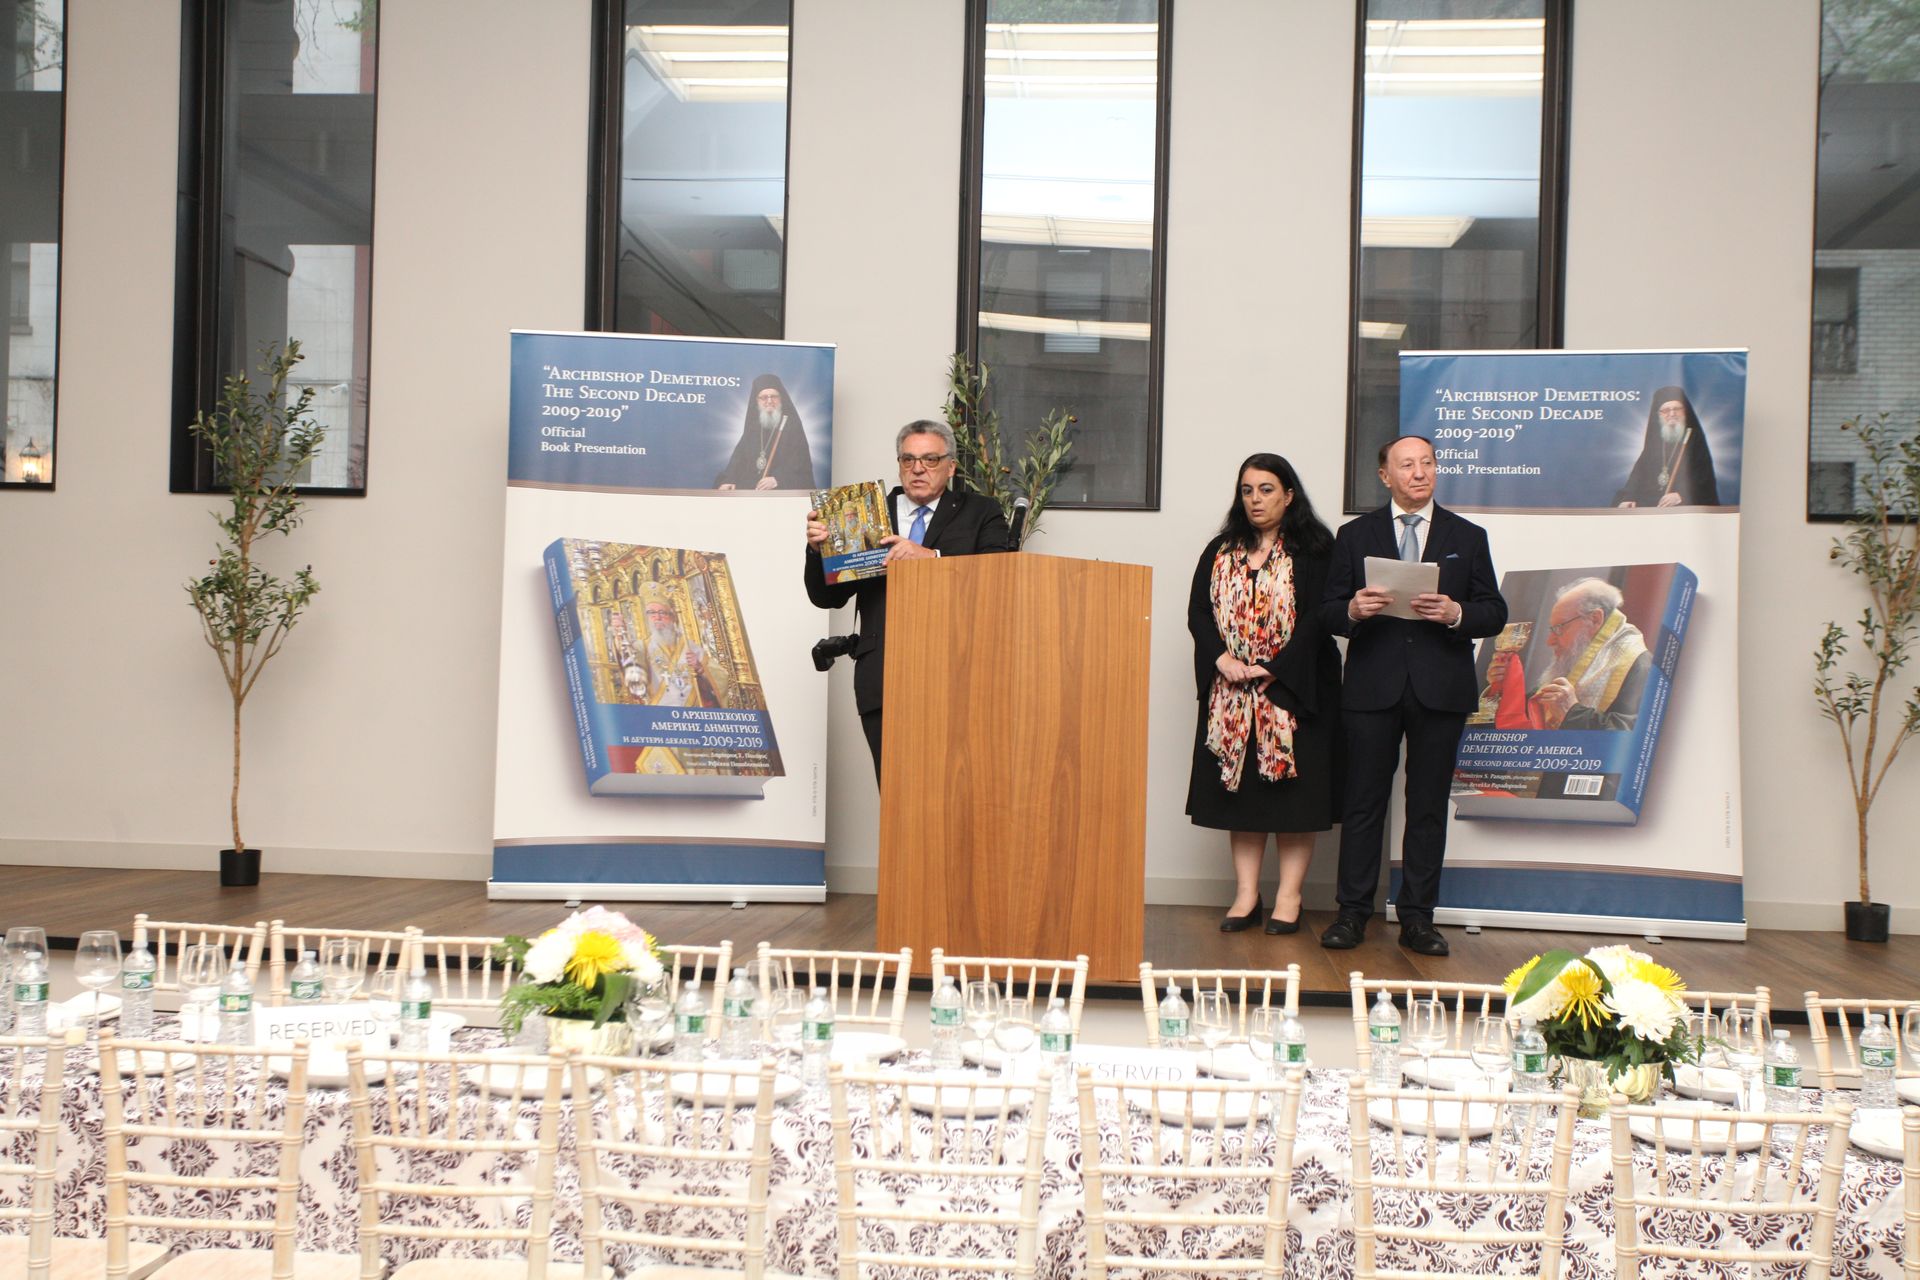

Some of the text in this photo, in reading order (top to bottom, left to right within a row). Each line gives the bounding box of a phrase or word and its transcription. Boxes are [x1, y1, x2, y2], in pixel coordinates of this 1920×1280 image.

[542, 383, 706, 404] THE SECOND DECADE
[542, 404, 629, 422] 2009-2019”
[1435, 406, 1604, 420] THE SECOND DECADE
[541, 426, 586, 438] Official
[1435, 424, 1524, 442] 2009-2019”
[541, 441, 647, 455] Book Presentation
[1434, 448, 1479, 460] Official
[1435, 464, 1541, 475] Book Presentation
[651, 721, 761, 734] ΑΜΕΡΙΚΗΣ ΔΗΜΗΤΡΙΟΣ
[702, 736, 763, 748] 2009-2019
[1465, 733, 1528, 742] ARCHBISHOP
[1462, 745, 1583, 755] DEMETRIOS OF AMERICA
[1533, 759, 1602, 771] 2009-2019
[270, 1019, 377, 1040] RESERVED
